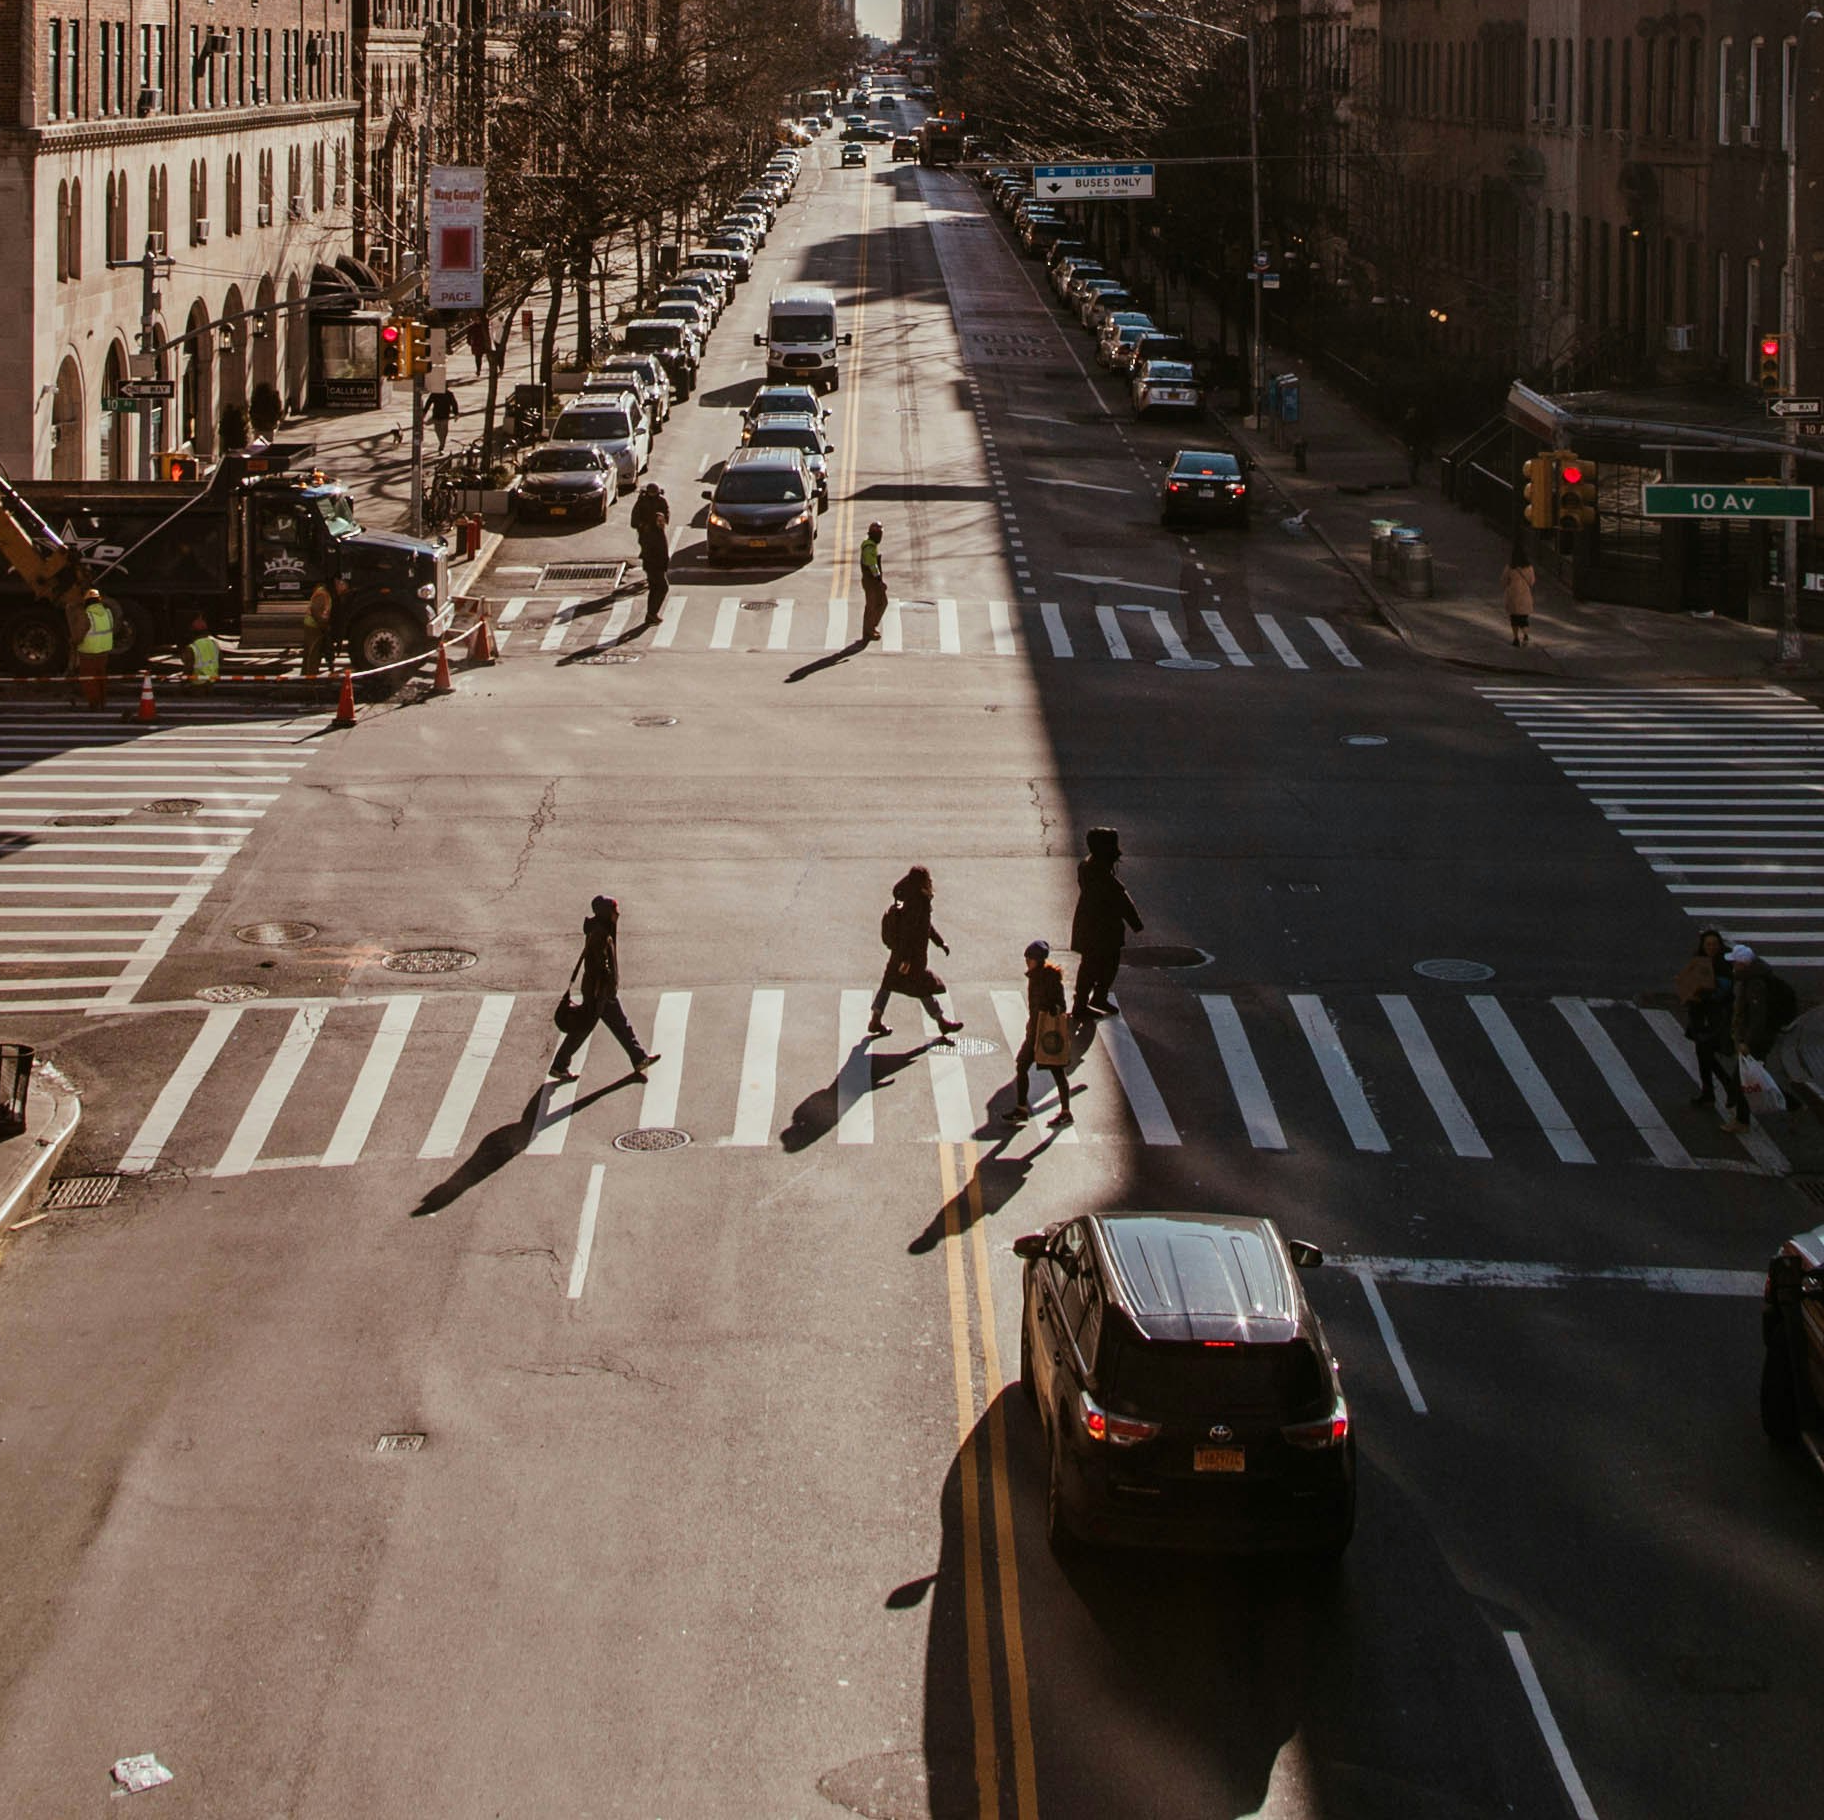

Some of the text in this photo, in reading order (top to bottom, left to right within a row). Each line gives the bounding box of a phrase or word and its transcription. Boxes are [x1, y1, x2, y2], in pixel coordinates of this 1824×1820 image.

[1071, 166, 1117, 175] BUS LANE
[1075, 177, 1141, 188] BUSES ONLY
[441, 292, 472, 302] PACE
[329, 387, 355, 395] CALLE
[107, 399, 119, 410] 10
[1799, 403, 1816, 412] WAY
[1805, 424, 1816, 435] 10
[1691, 493, 1754, 510] 10 Av
